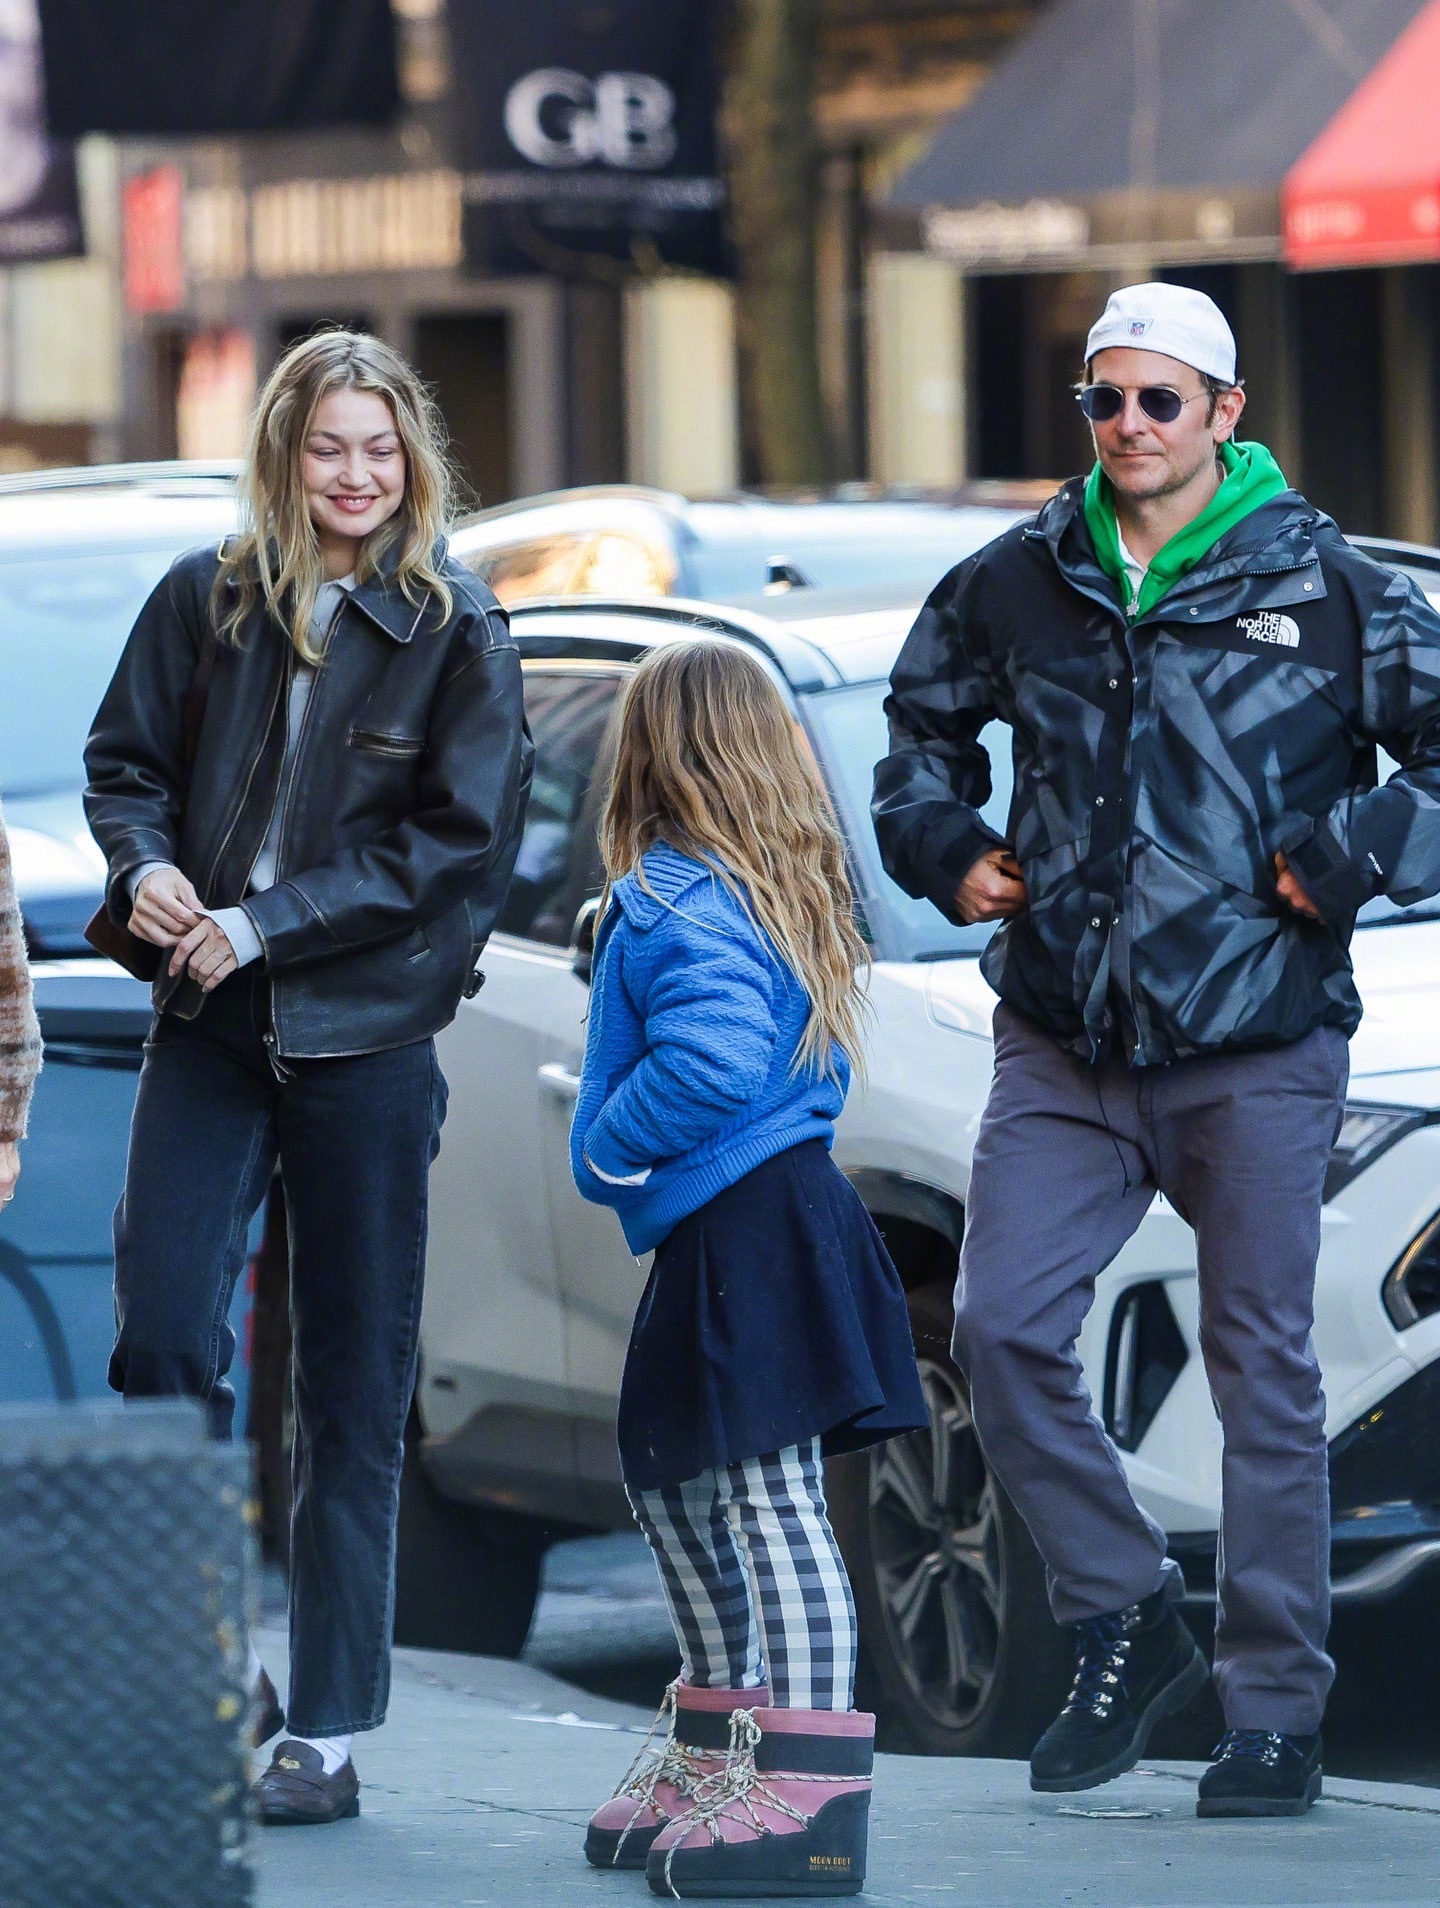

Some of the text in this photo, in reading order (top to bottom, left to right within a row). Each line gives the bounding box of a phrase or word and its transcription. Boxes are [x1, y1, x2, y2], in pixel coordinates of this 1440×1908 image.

[503, 66, 677, 170] GB
[1258, 611, 1280, 623] THE
[1236, 618, 1279, 633] NORTH
[1246, 629, 1277, 643] FACE
